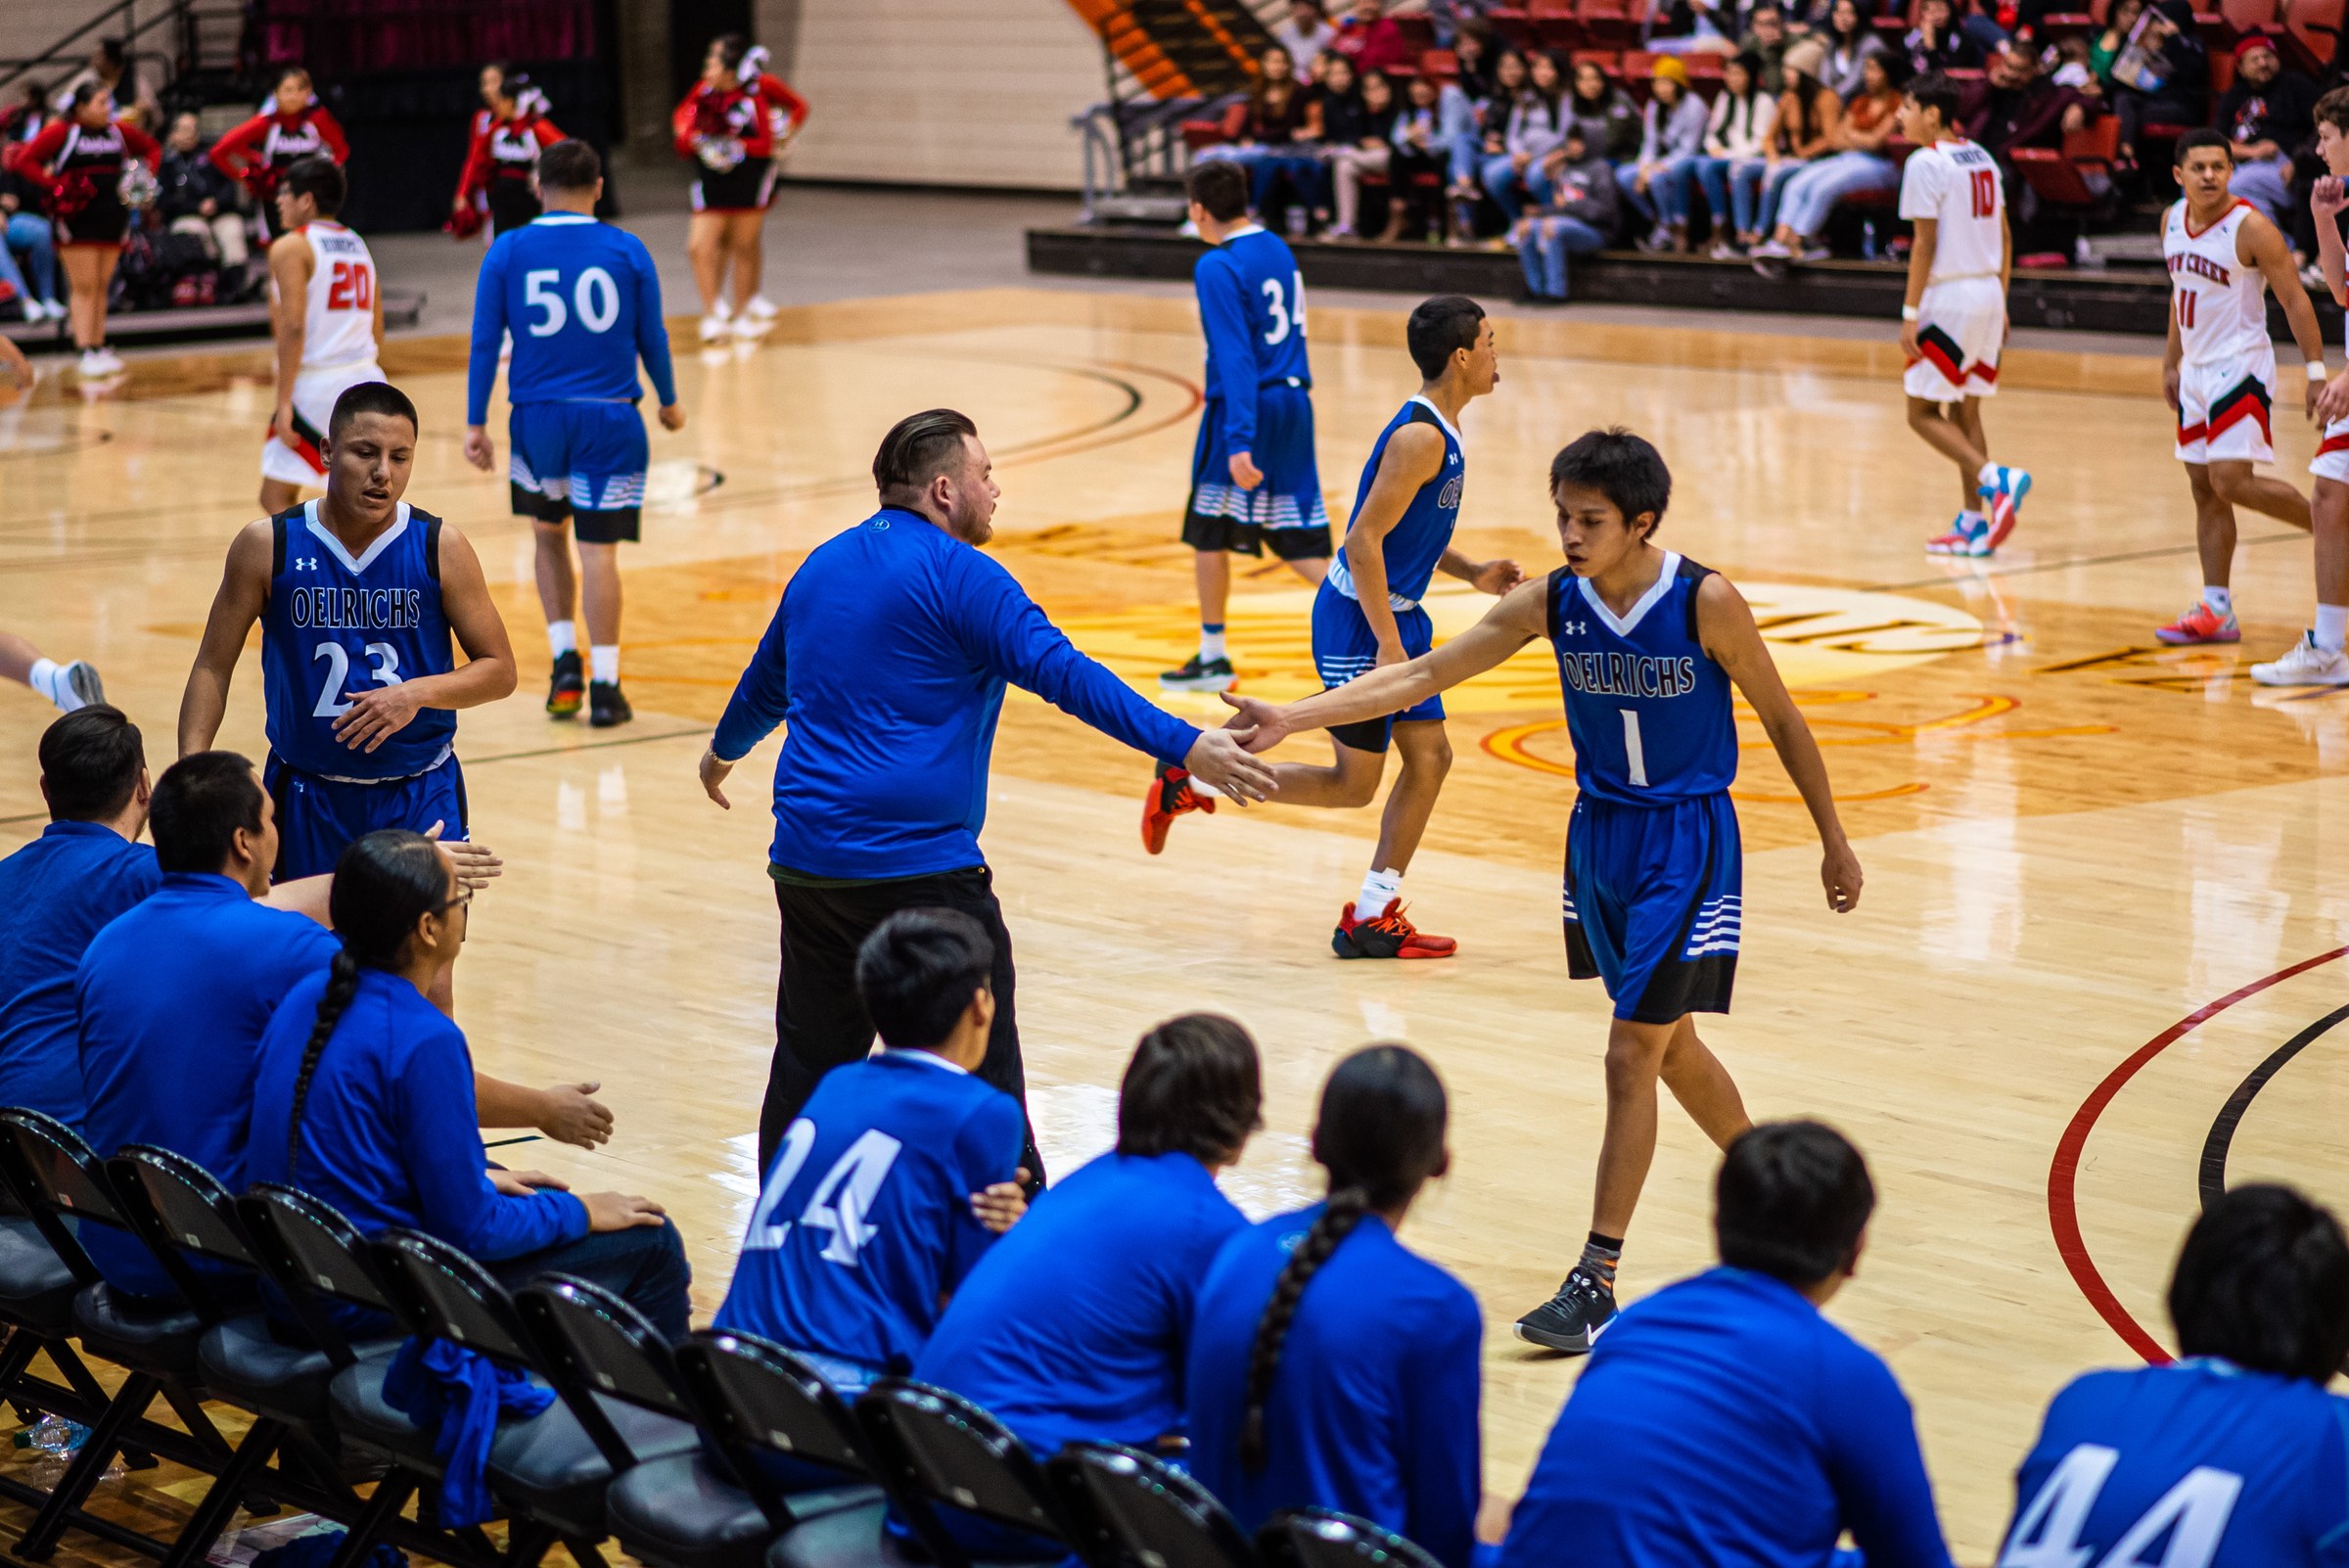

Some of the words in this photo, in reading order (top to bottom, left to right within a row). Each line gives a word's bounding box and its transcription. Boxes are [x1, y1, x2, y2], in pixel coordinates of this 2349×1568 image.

[1970, 168, 1995, 218] 10
[328, 261, 369, 310] 20
[2188, 253, 2231, 288] CREEK
[526, 266, 620, 337] 50
[1262, 270, 1307, 345] 34
[2180, 289, 2196, 329] 11
[291, 586, 420, 629] OELRICHS
[1563, 652, 1696, 698] OELRICHS
[1619, 709, 1650, 787] 1
[743, 1117, 902, 1268] 24
[2000, 1442, 2244, 1568] 44
